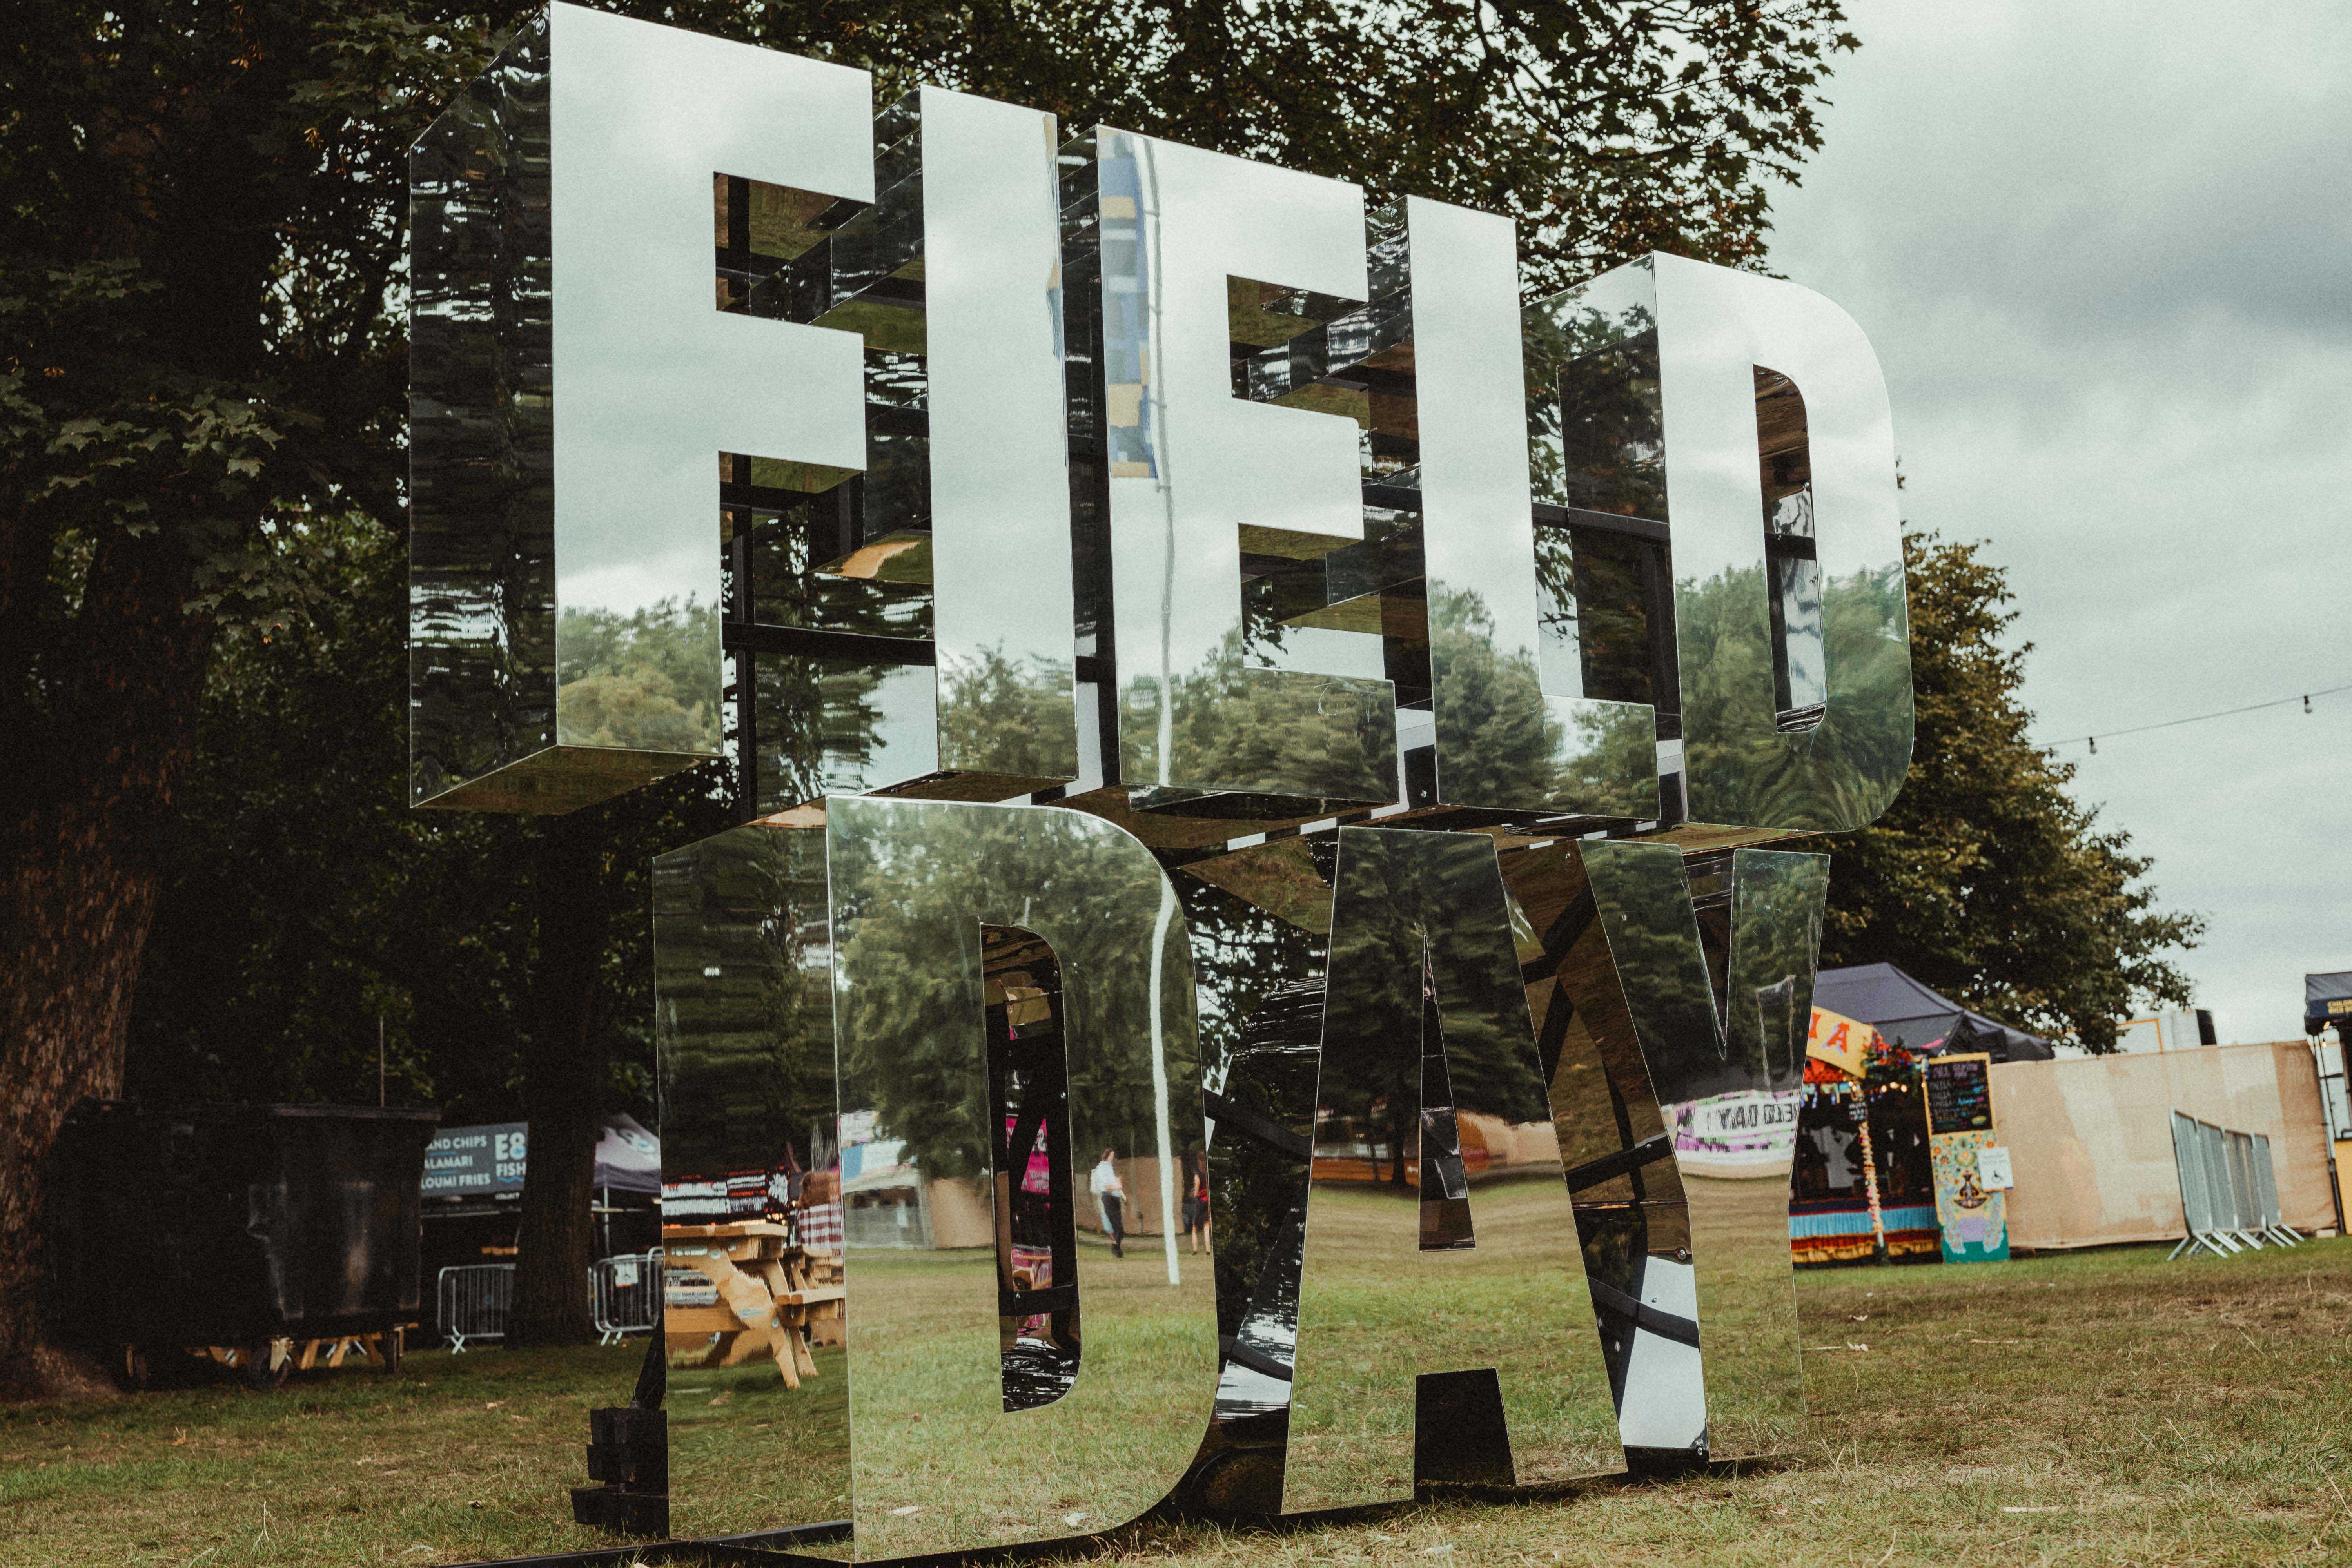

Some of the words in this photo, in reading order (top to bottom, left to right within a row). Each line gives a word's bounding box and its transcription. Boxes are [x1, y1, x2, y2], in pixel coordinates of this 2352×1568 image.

[548, 0, 1914, 835] FIELD
[453, 1135, 487, 1149] CHIPS
[495, 1132, 526, 1160] E8
[459, 1172, 490, 1187] FRIES
[496, 1162, 526, 1177] FISH
[825, 794, 1831, 1564] DAY
